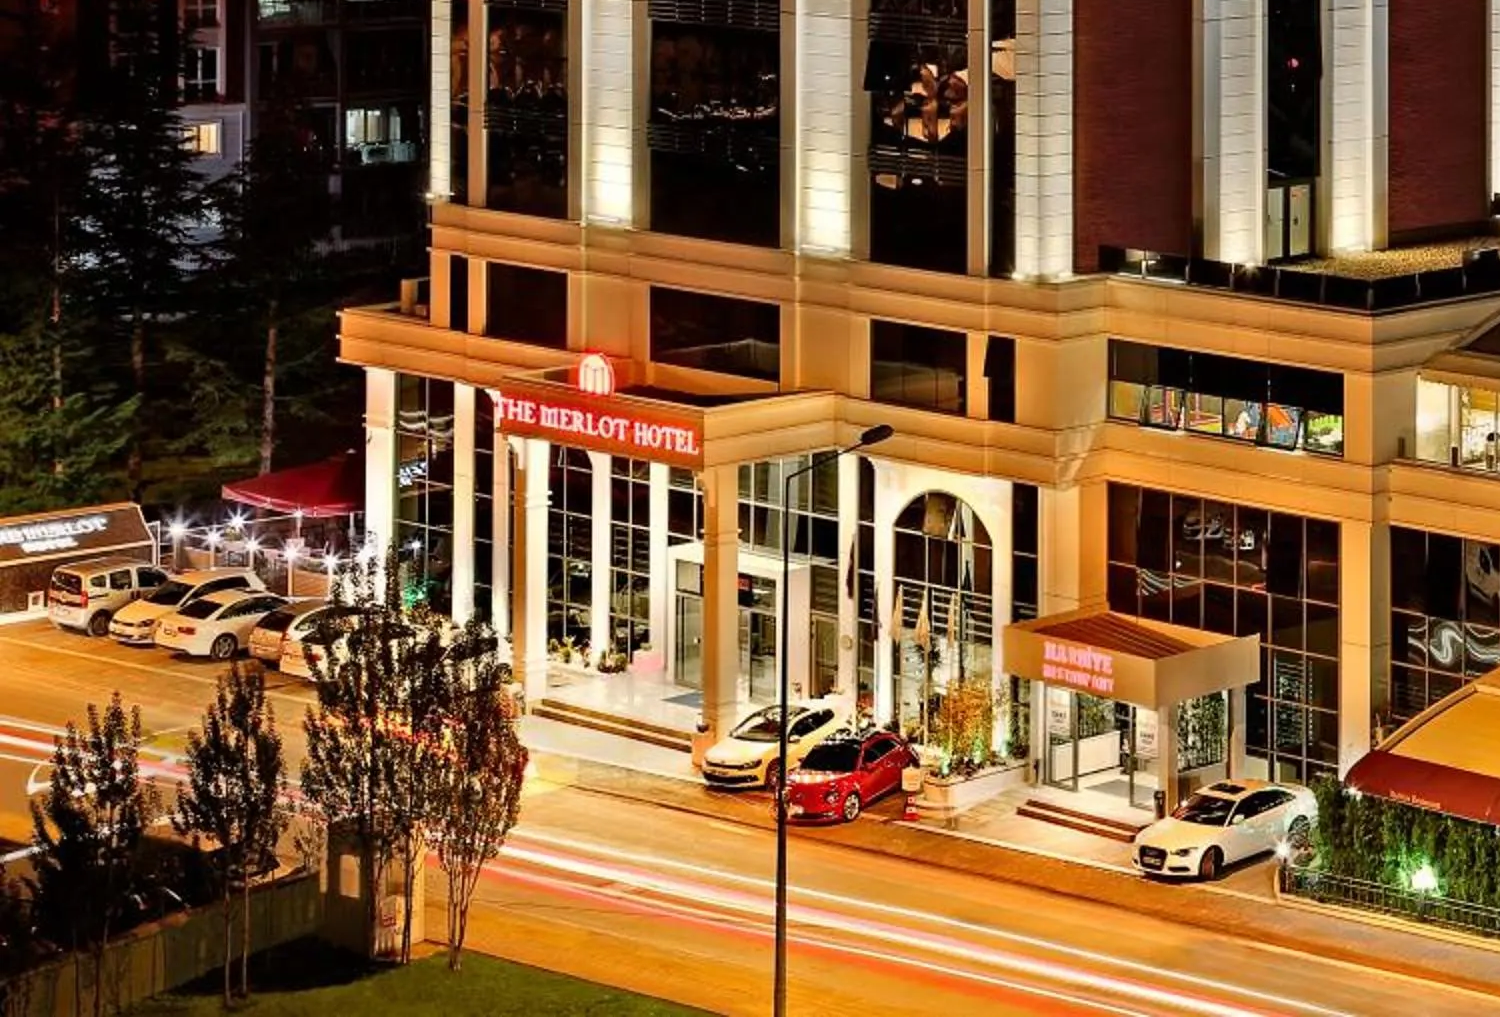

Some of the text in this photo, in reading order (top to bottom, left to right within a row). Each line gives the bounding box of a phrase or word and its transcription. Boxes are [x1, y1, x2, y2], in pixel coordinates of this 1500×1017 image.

[498, 396, 699, 455] THE MERLOT HOTEL
